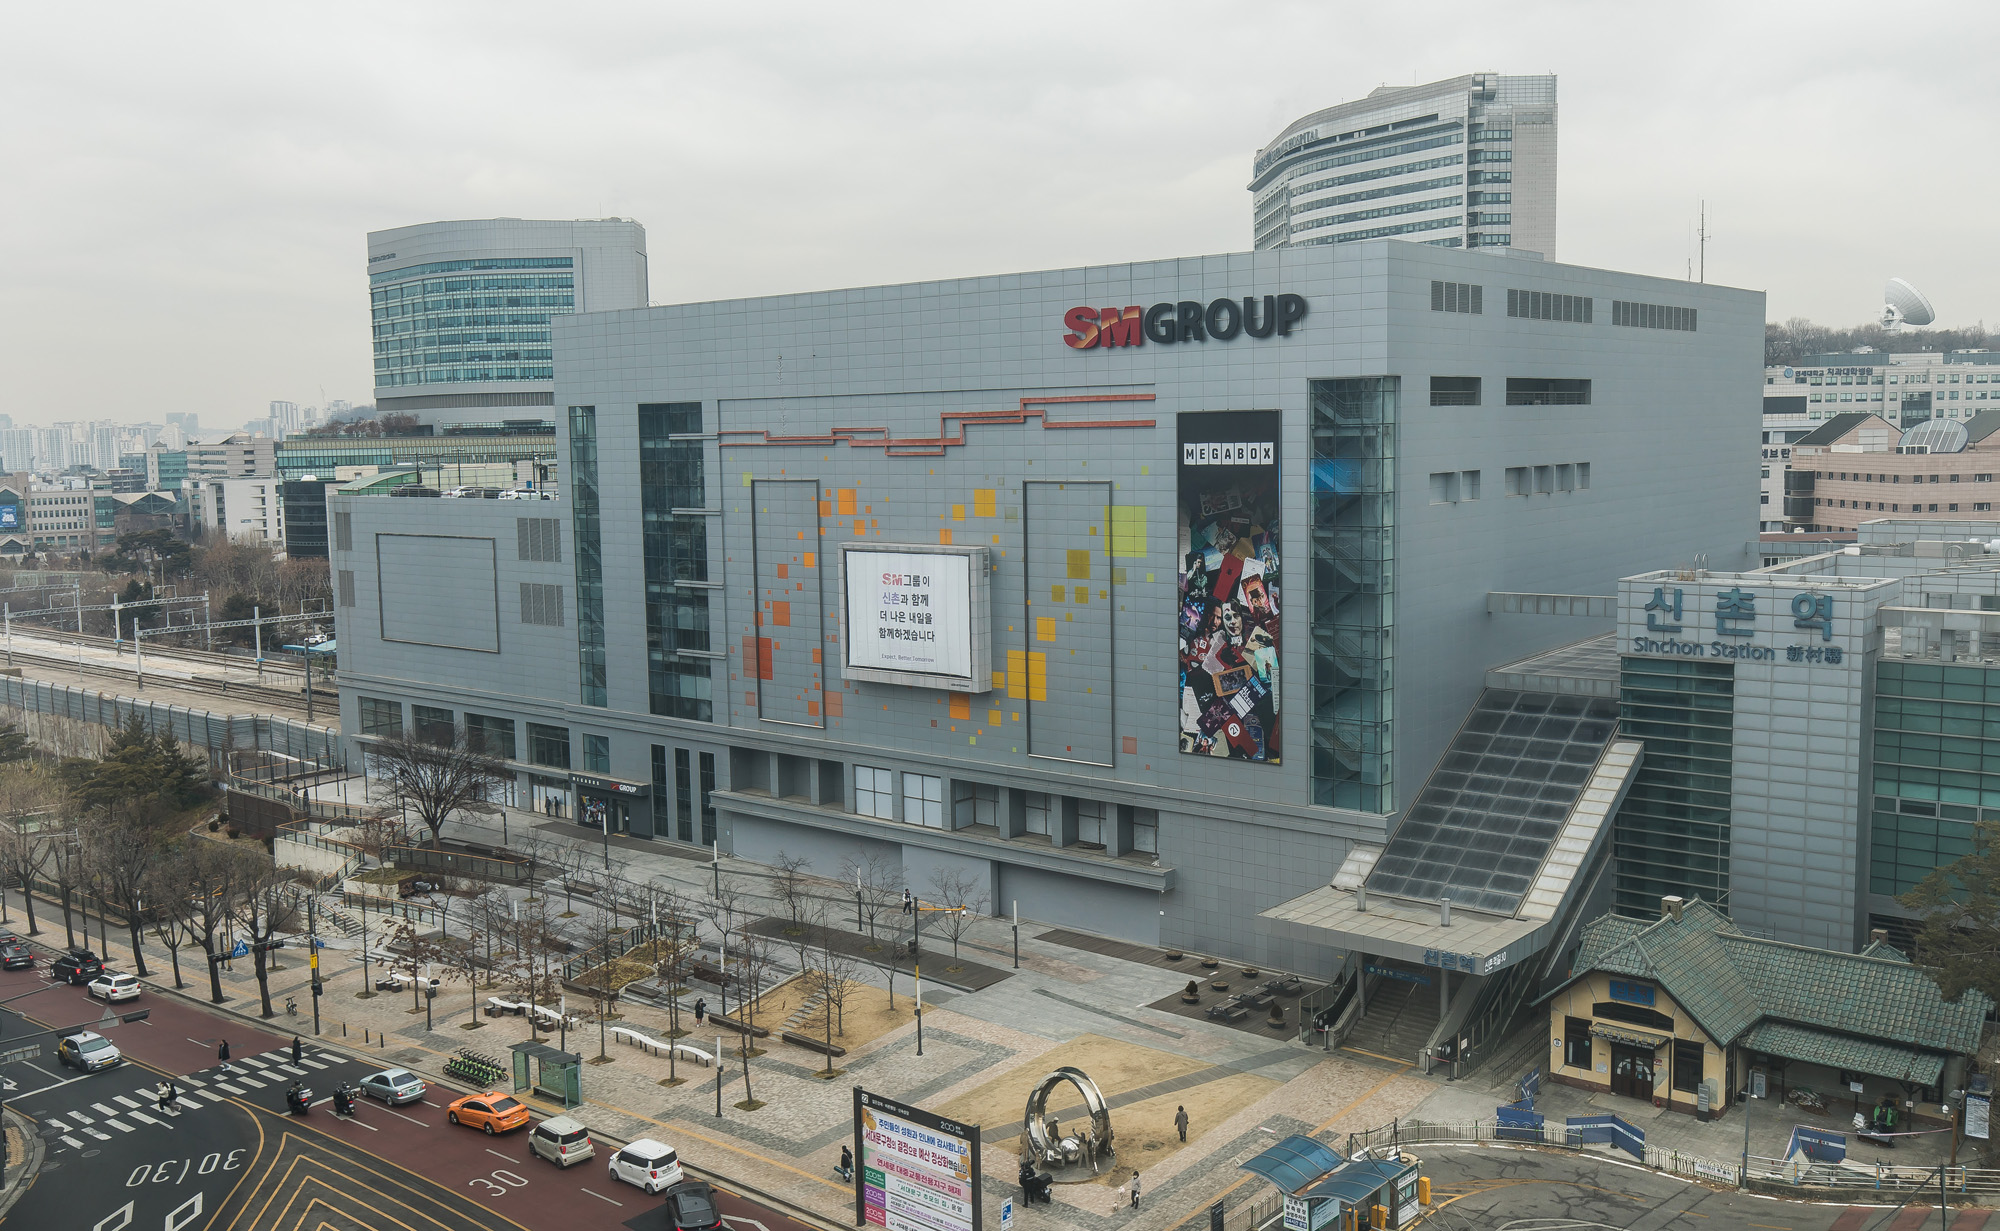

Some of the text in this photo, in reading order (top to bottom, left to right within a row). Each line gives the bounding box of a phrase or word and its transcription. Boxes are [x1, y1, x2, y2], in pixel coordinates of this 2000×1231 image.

[1827, 367, 1873, 377] 치과대학병원
[1185, 445, 1272, 461] MEGABOX
[882, 592, 929, 607] 신촌과 함께
[880, 610, 932, 625] 더 나은 내일을
[879, 627, 935, 642] 함께하겠습니다
[1634, 636, 1775, 660] Sinchon Station
[1242, 686, 1250, 695] ALL
[1239, 690, 1255, 708] ACCESS
[879, 1118, 900, 1134] 주민들의
[901, 1126, 918, 1140] 성원과
[919, 1132, 936, 1145] 인내에
[877, 1158, 895, 1172] 연세로
[468, 1170, 529, 1197] 30
